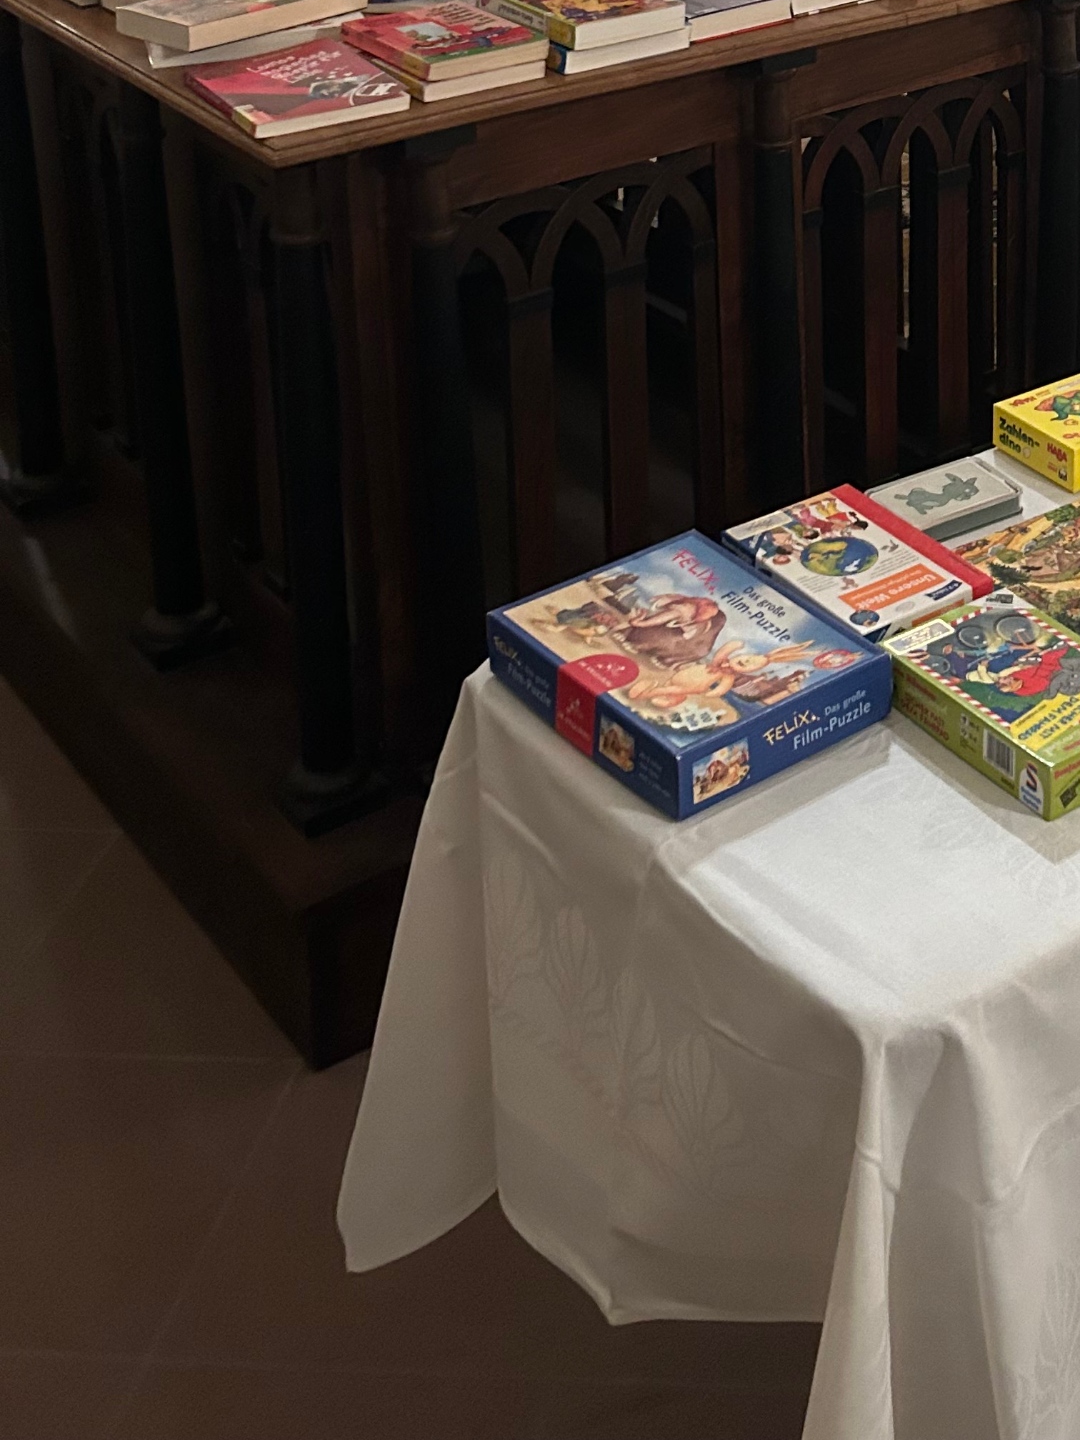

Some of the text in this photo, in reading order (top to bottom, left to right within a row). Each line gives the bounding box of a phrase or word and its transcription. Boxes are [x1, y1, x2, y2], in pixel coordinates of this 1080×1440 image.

[999, 417, 1040, 449] Zahlen-
[999, 433, 1021, 454] dino
[1047, 442, 1067, 462] HABA
[672, 547, 719, 587] FELIX
[721, 591, 791, 641] Film-Puzzle
[743, 586, 785, 618] Das große
[825, 689, 866, 716] Das große
[763, 710, 810, 746] FELIX
[793, 702, 871, 750] Film-Puzzle
